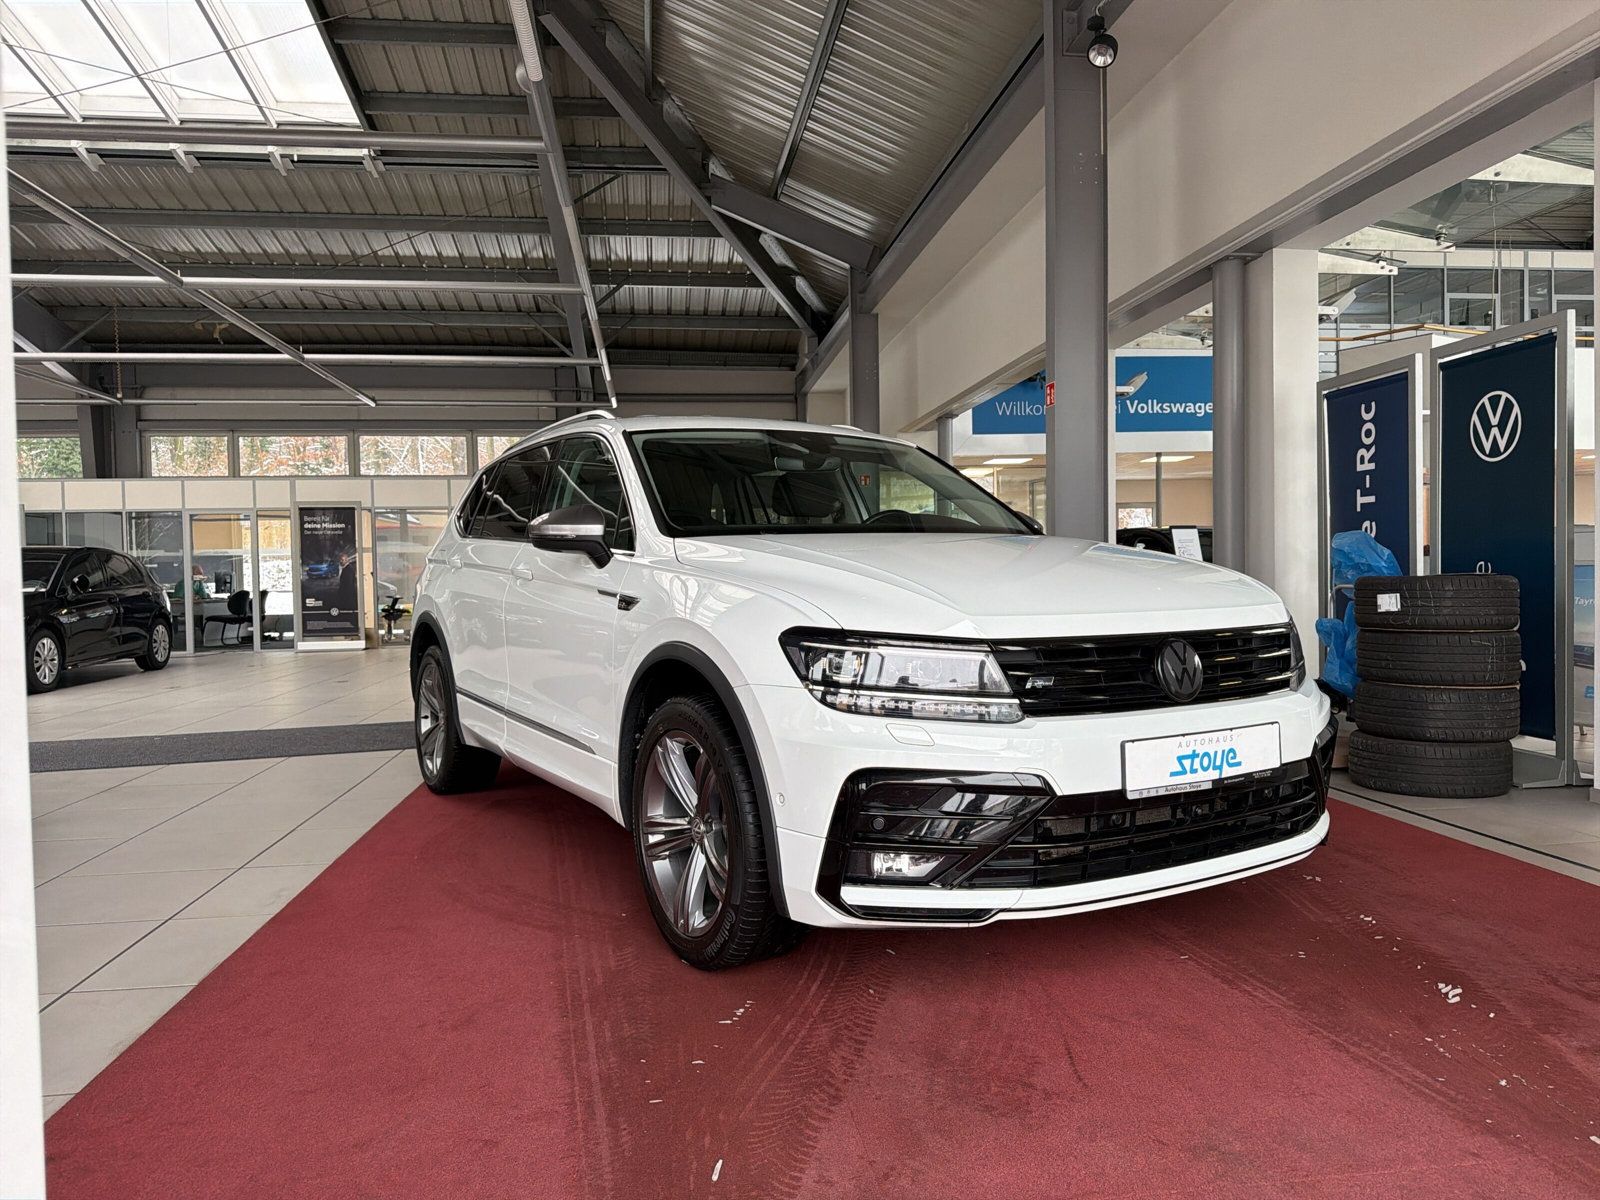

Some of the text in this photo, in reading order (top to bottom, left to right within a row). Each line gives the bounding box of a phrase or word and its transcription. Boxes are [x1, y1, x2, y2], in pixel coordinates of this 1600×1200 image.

[995, 401, 1047, 416] Willko
[1356, 400, 1377, 512] T-Roc
[1177, 734, 1234, 749] AUTOHAUS
[1164, 783, 1202, 793] Autohaus Stoye
